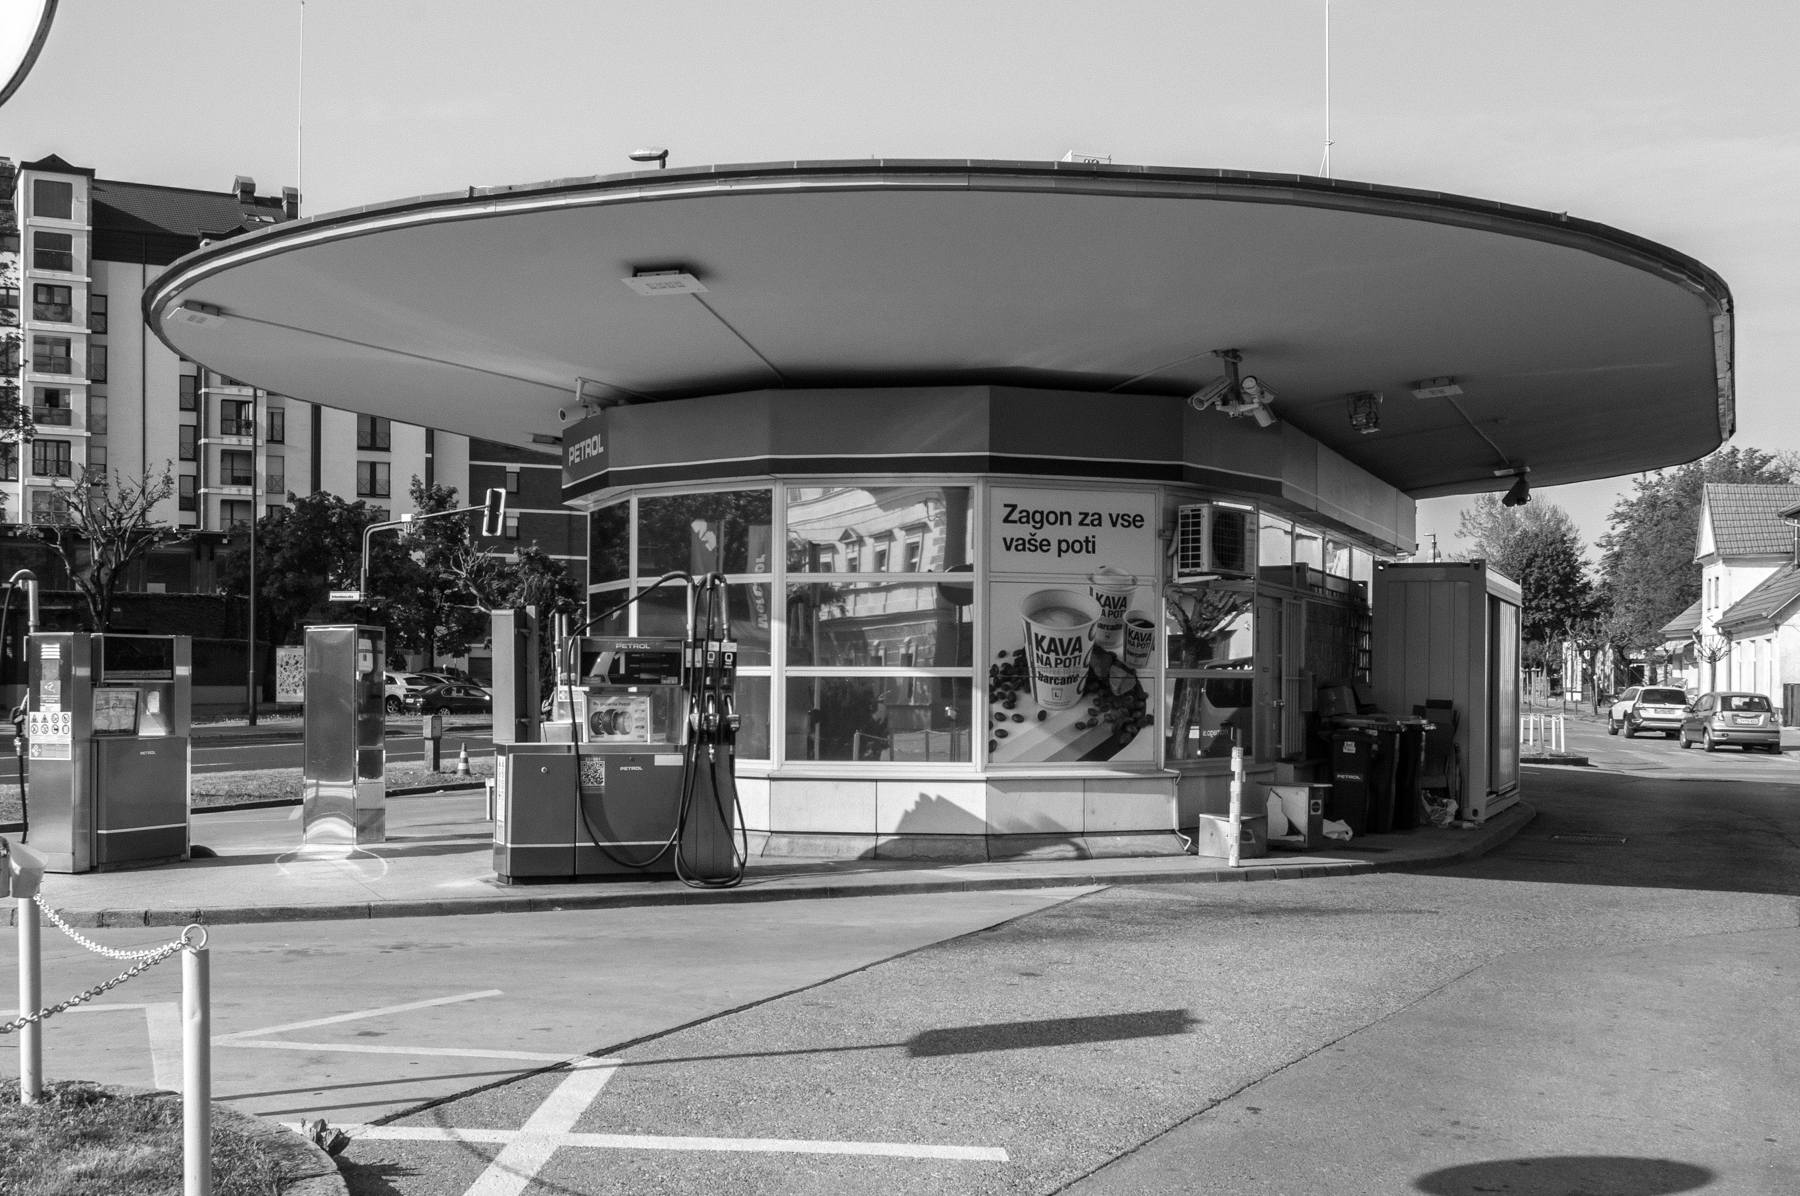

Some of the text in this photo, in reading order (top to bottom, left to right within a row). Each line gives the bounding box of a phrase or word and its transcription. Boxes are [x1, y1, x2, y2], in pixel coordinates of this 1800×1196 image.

[569, 434, 604, 466] PETROL
[1002, 503, 1145, 530] Zagon za vse
[1002, 532, 1096, 558] vaše poti
[1095, 592, 1127, 610] KAVA
[1034, 632, 1083, 657] KAVA
[1128, 628, 1152, 643] KAVA
[1036, 652, 1053, 668] NA
[1054, 654, 1082, 668] POTI
